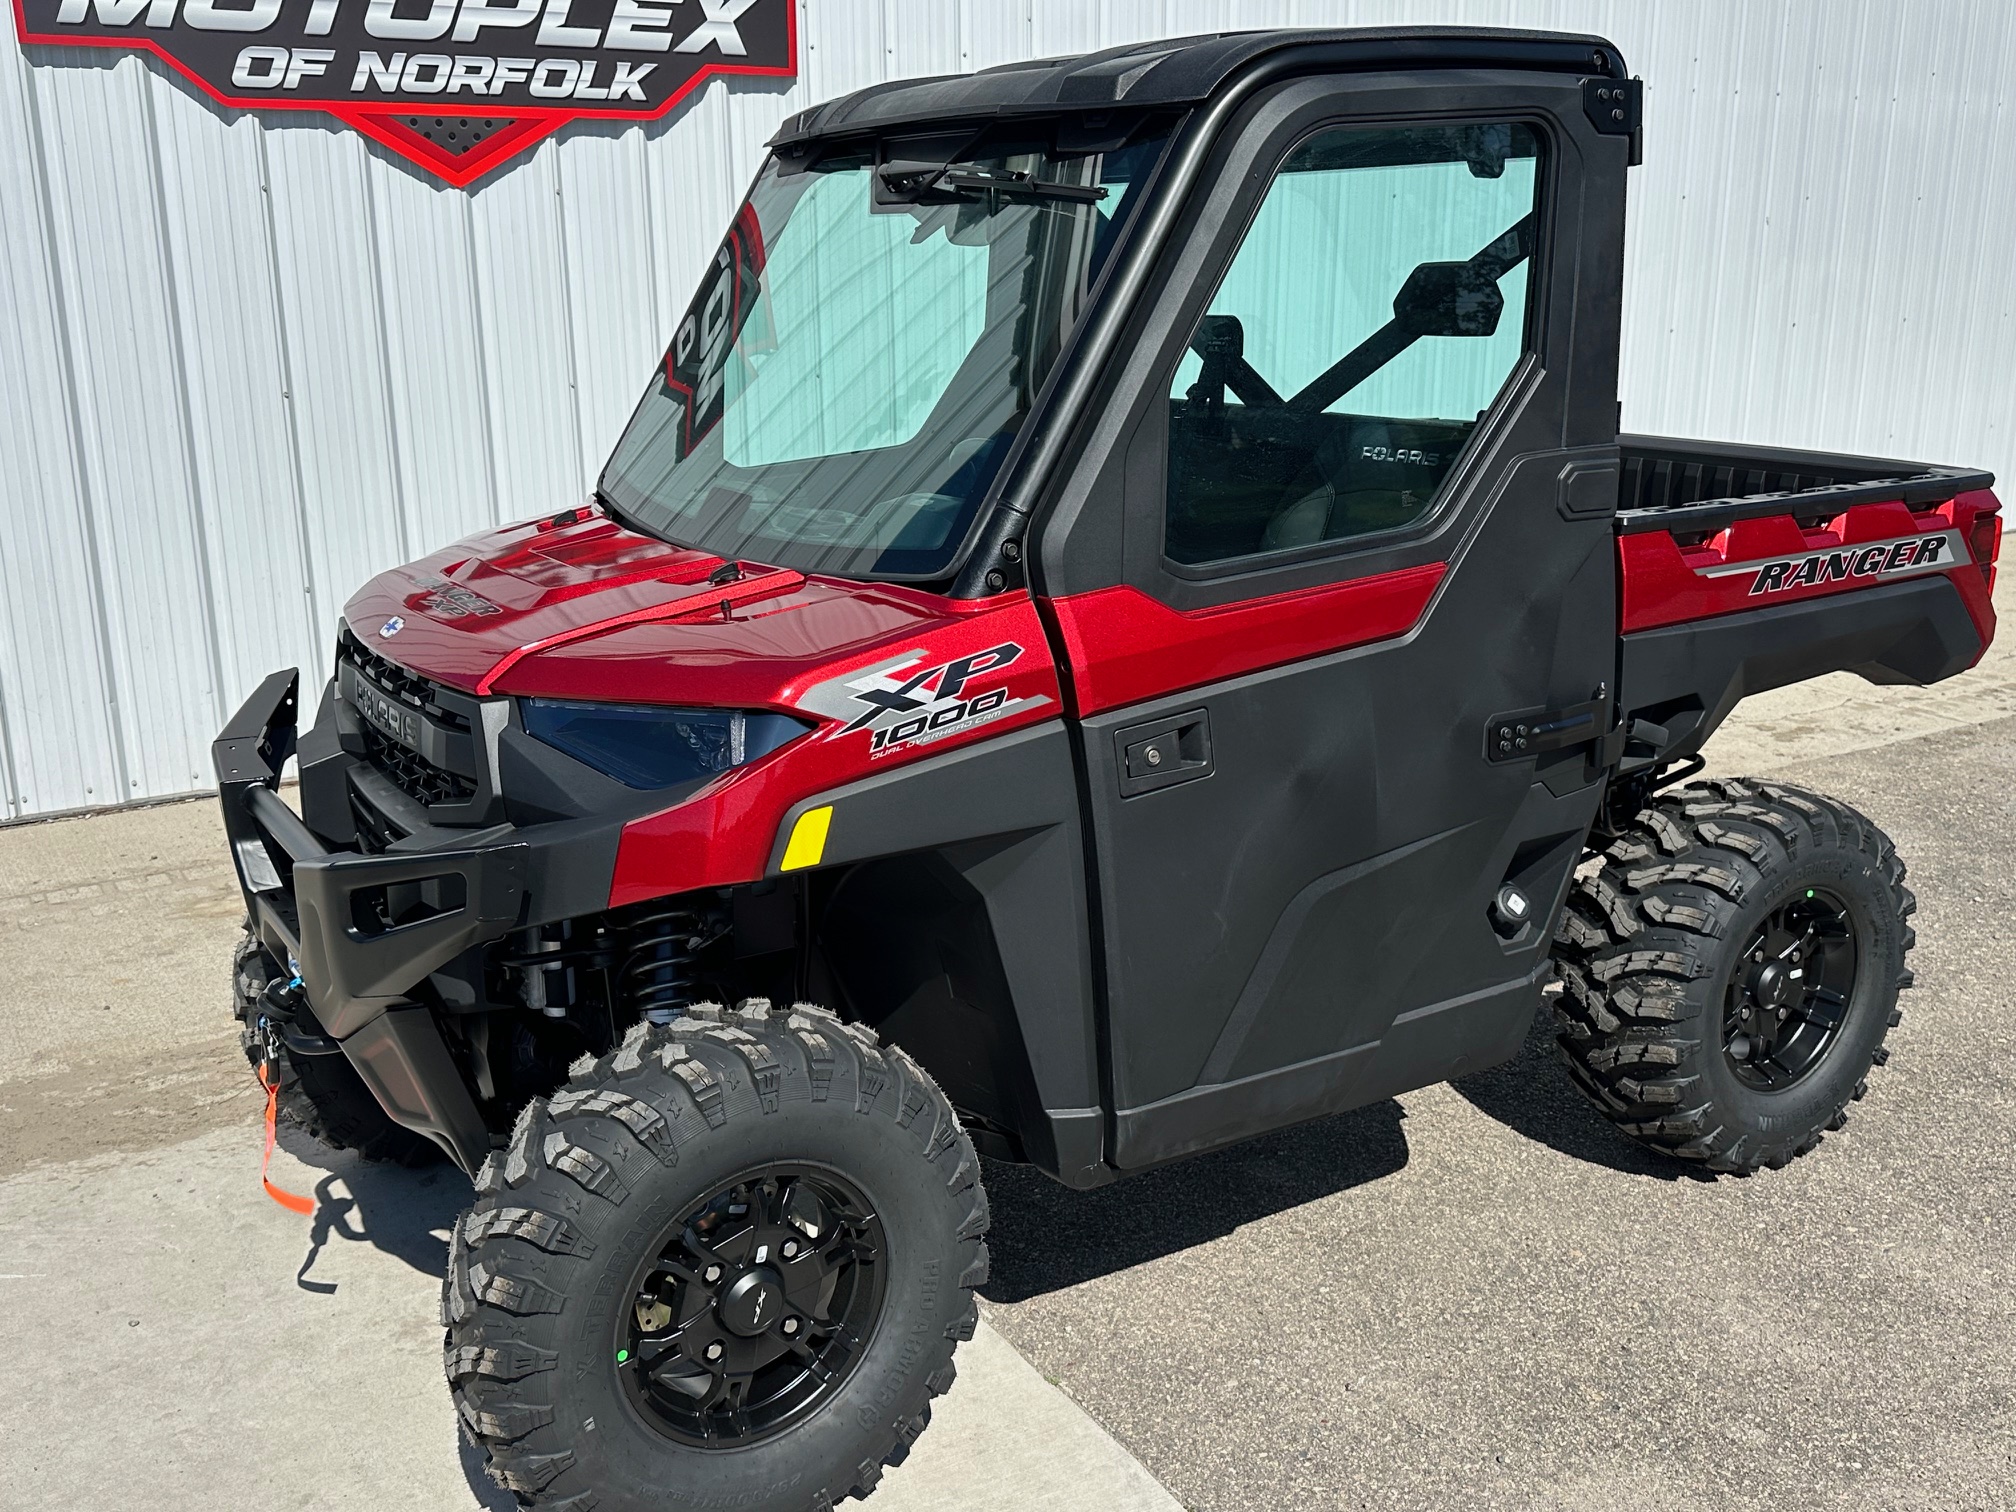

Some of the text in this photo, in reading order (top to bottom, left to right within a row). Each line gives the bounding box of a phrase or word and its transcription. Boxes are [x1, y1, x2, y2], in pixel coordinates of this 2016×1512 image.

[231, 46, 658, 100] OF NORFOLK
[1361, 446, 1440, 466] POLARIS
[1748, 535, 1948, 596] RANGER
[419, 597, 469, 616] XP
[357, 680, 418, 747] POLARIS
[825, 641, 1025, 742] XP
[870, 687, 1008, 753] 1000
[871, 711, 1002, 760] DUAL OVERHEAD CAM
[576, 1194, 673, 1383] X-TERRAIN
